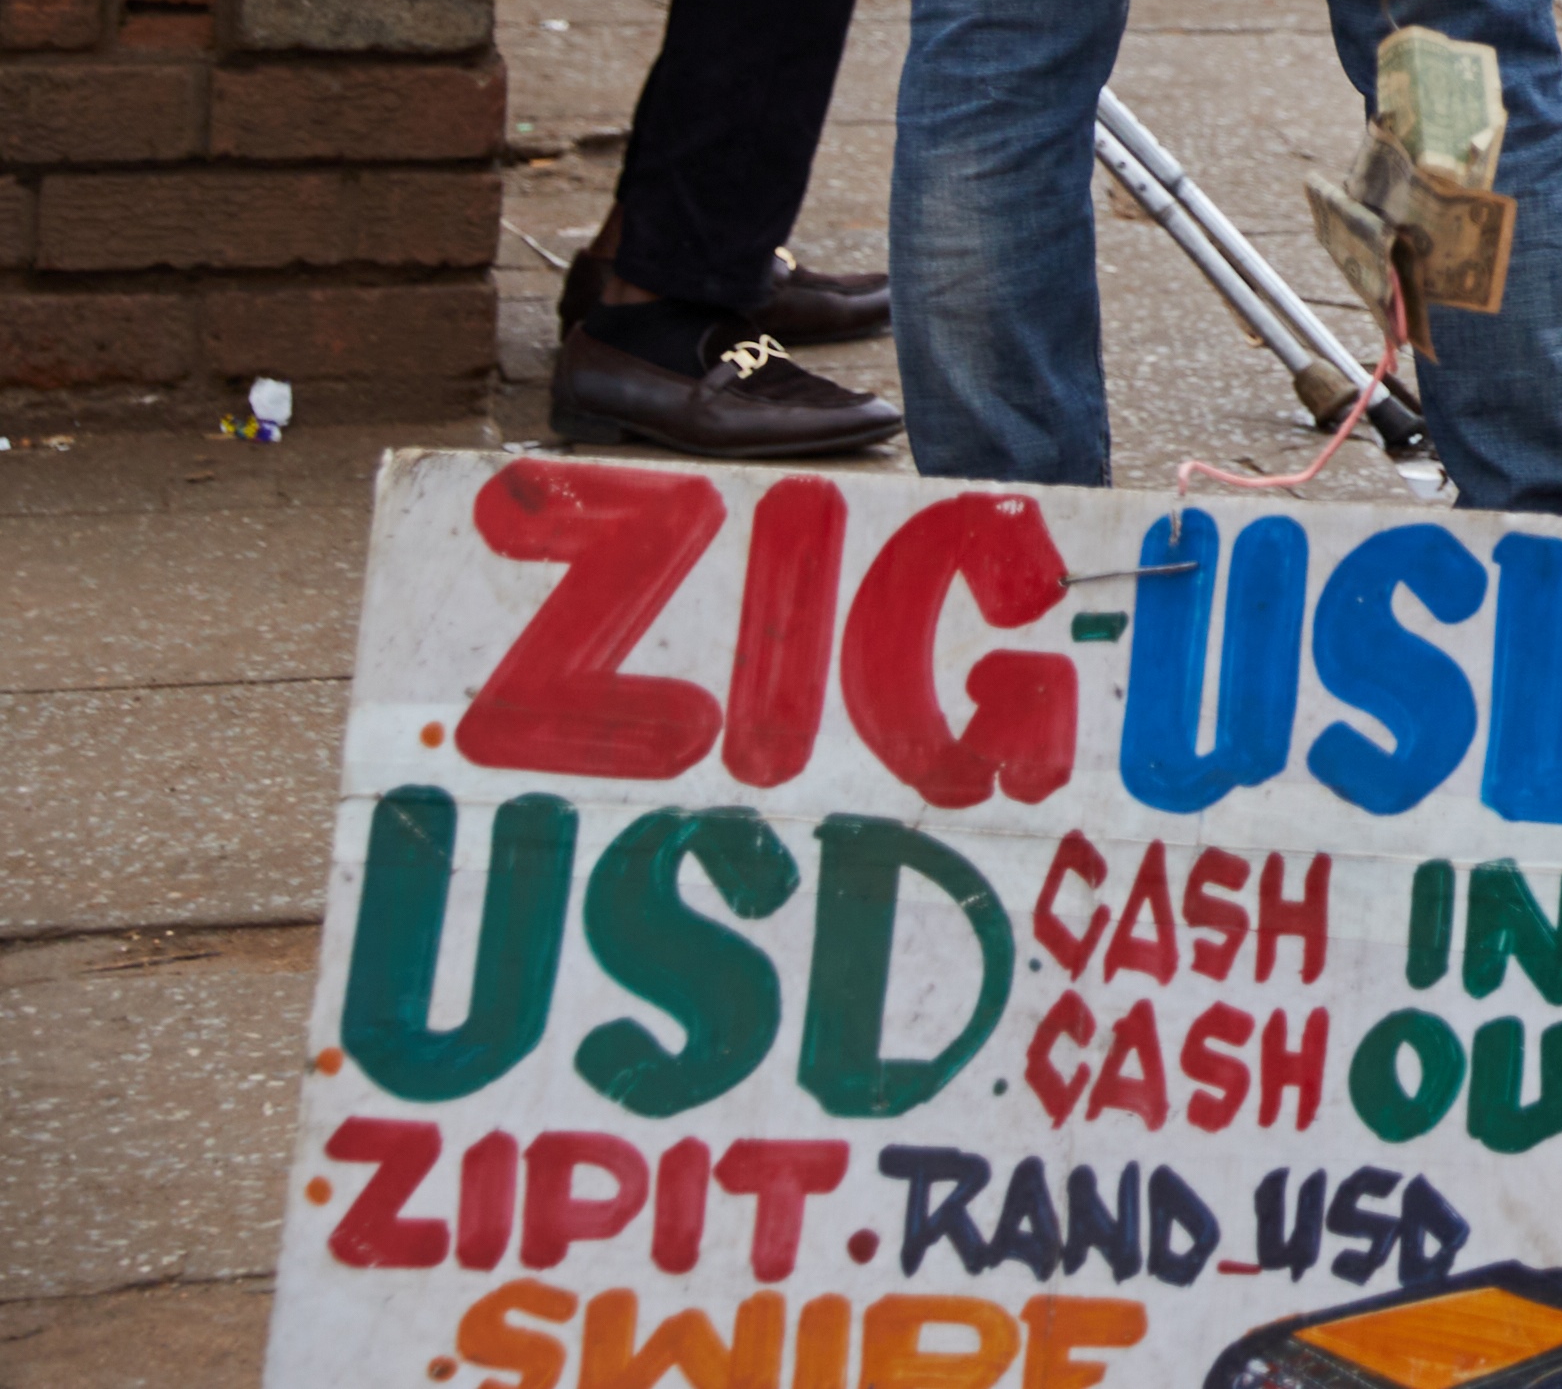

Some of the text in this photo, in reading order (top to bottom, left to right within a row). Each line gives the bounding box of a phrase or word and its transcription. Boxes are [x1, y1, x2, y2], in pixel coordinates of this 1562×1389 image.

[340, 785, 1016, 1118] USD
[1030, 830, 1332, 986] CASH
[1022, 991, 1331, 1132] CASH
[322, 1119, 850, 1276] ZIPIT
